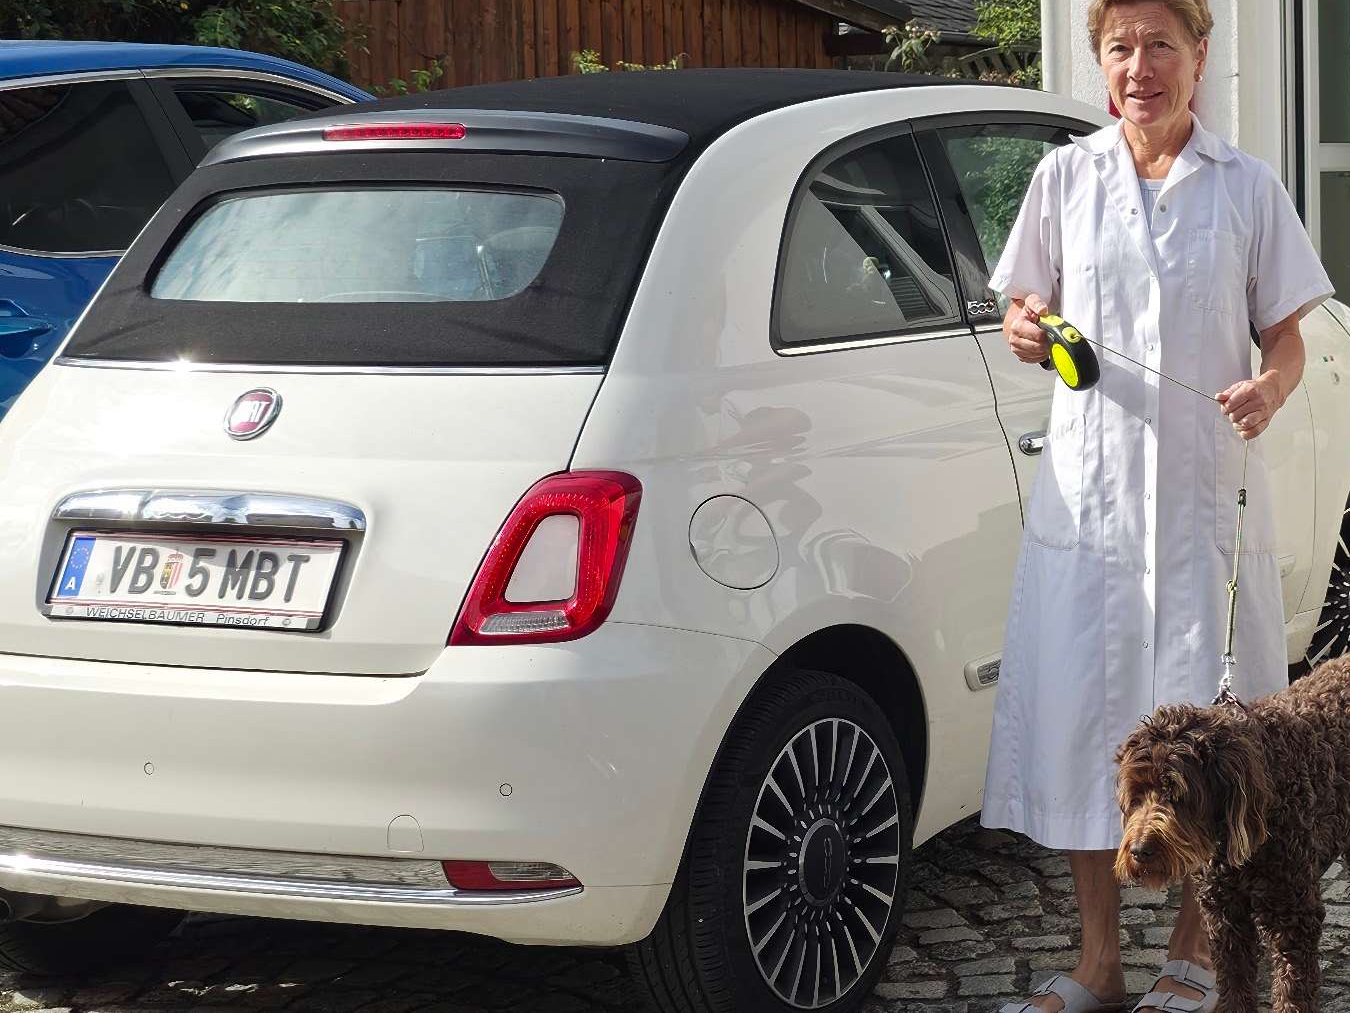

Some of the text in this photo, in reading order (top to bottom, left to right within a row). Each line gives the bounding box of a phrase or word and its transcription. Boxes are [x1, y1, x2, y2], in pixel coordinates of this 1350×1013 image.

[109, 545, 311, 603] VB 5 MBT
[63, 575, 77, 590] A
[215, 613, 270, 626] Pinsdorf
